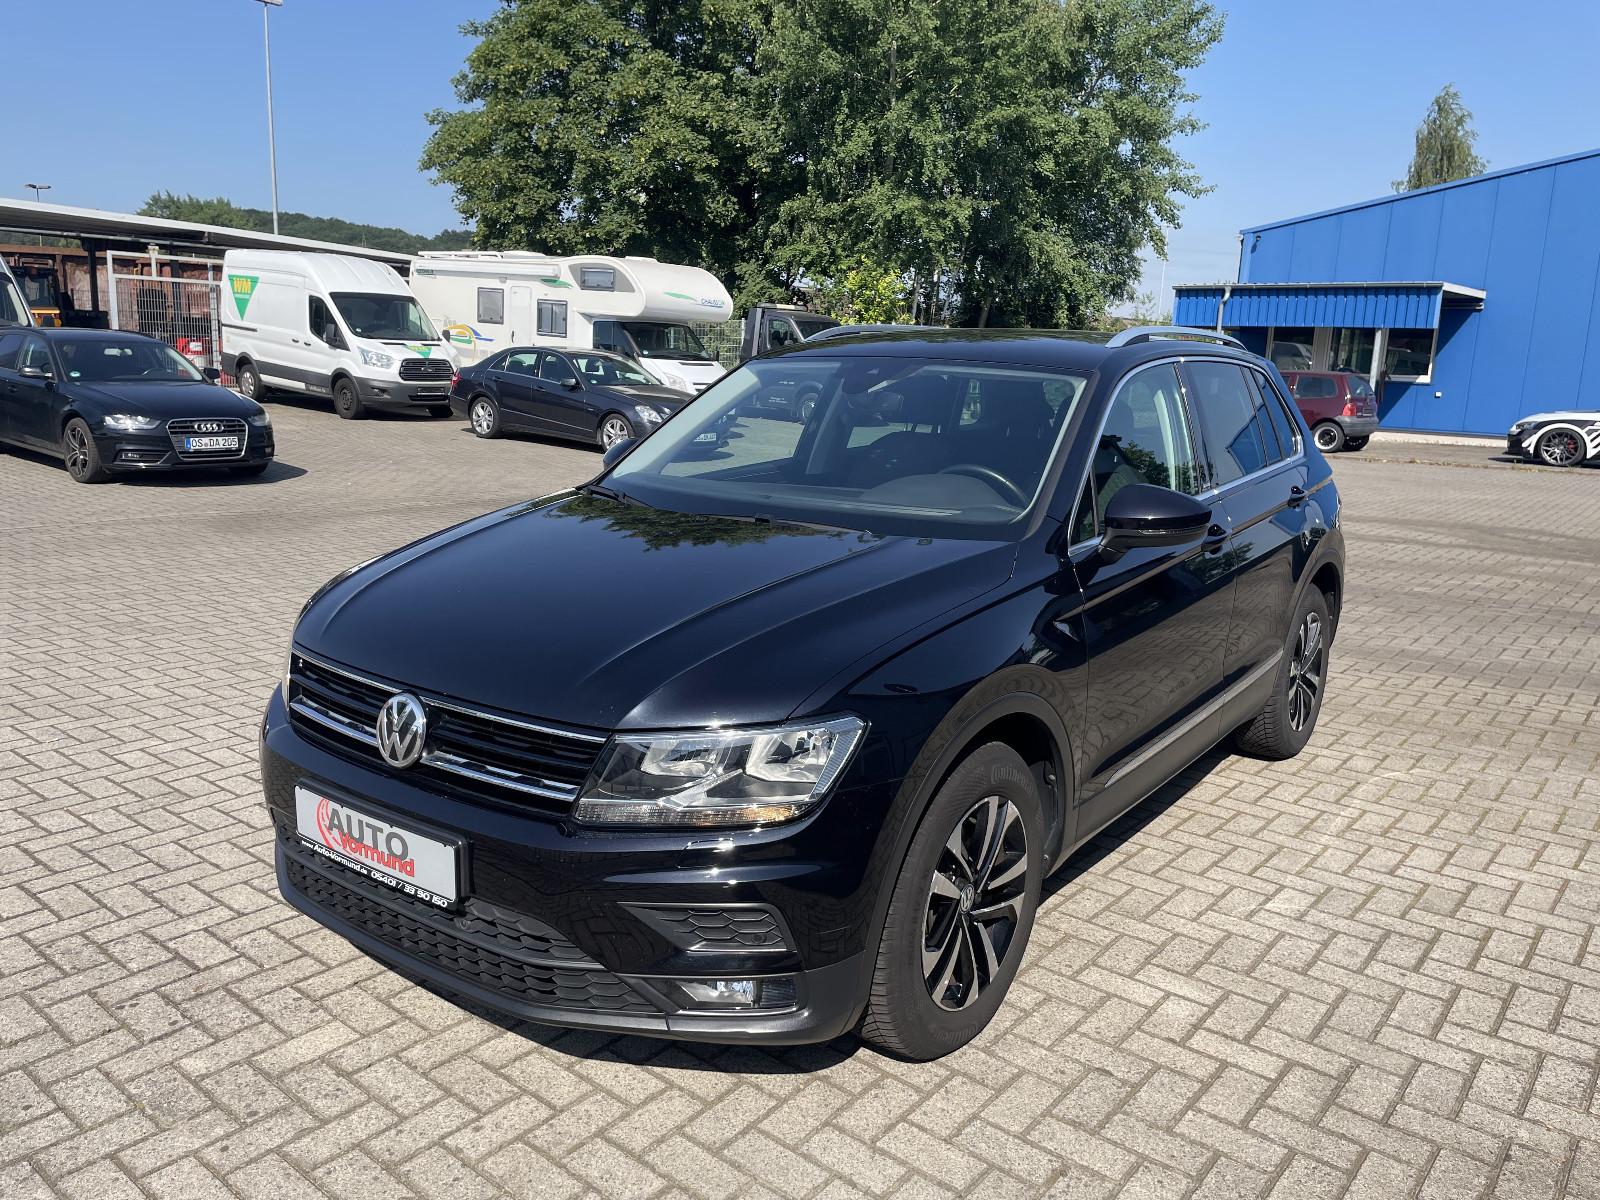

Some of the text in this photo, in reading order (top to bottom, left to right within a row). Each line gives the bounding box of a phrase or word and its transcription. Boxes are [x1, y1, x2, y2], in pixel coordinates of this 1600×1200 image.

[233, 277, 252, 294] WM
[191, 437, 238, 448] OS DA 205
[327, 807, 409, 861] AUTO
[338, 830, 415, 877] Vormund
[371, 870, 397, 887] 05401
